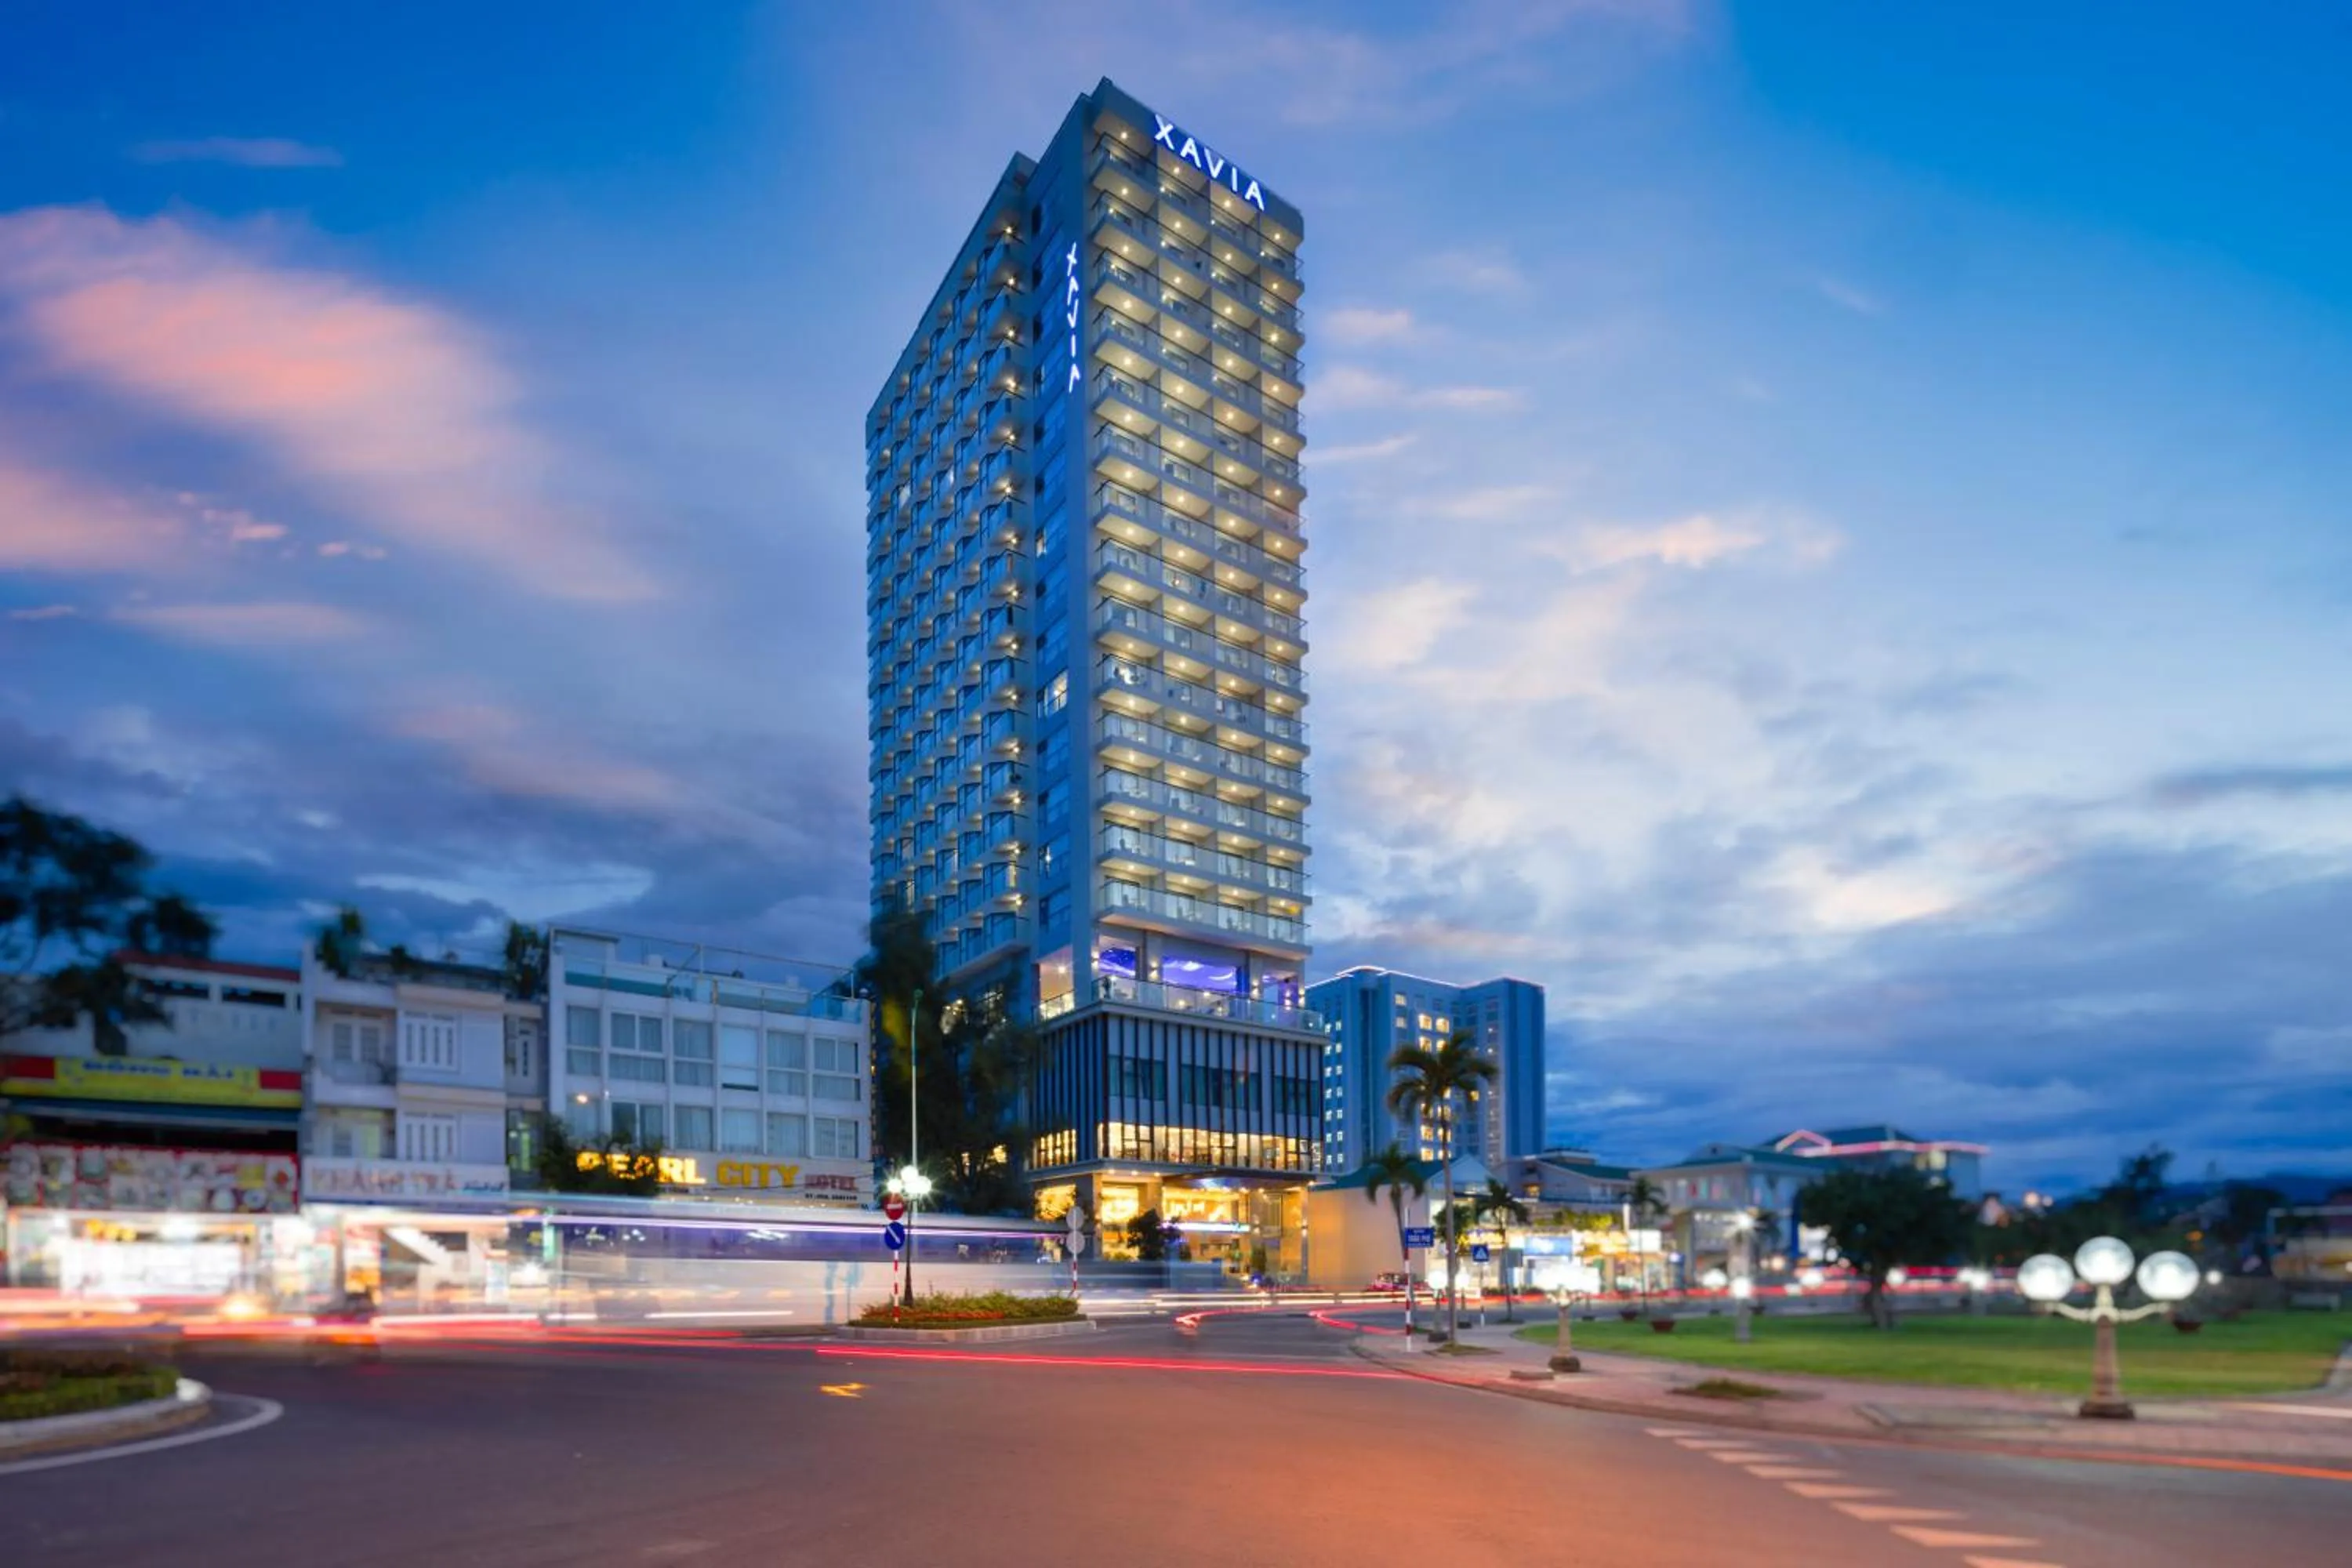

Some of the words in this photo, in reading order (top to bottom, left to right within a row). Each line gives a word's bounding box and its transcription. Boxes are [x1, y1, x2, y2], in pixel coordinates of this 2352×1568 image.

[1154, 114, 1265, 211] XAVIA
[1066, 241, 1081, 393] XAVIA
[716, 1160, 800, 1189] CITY
